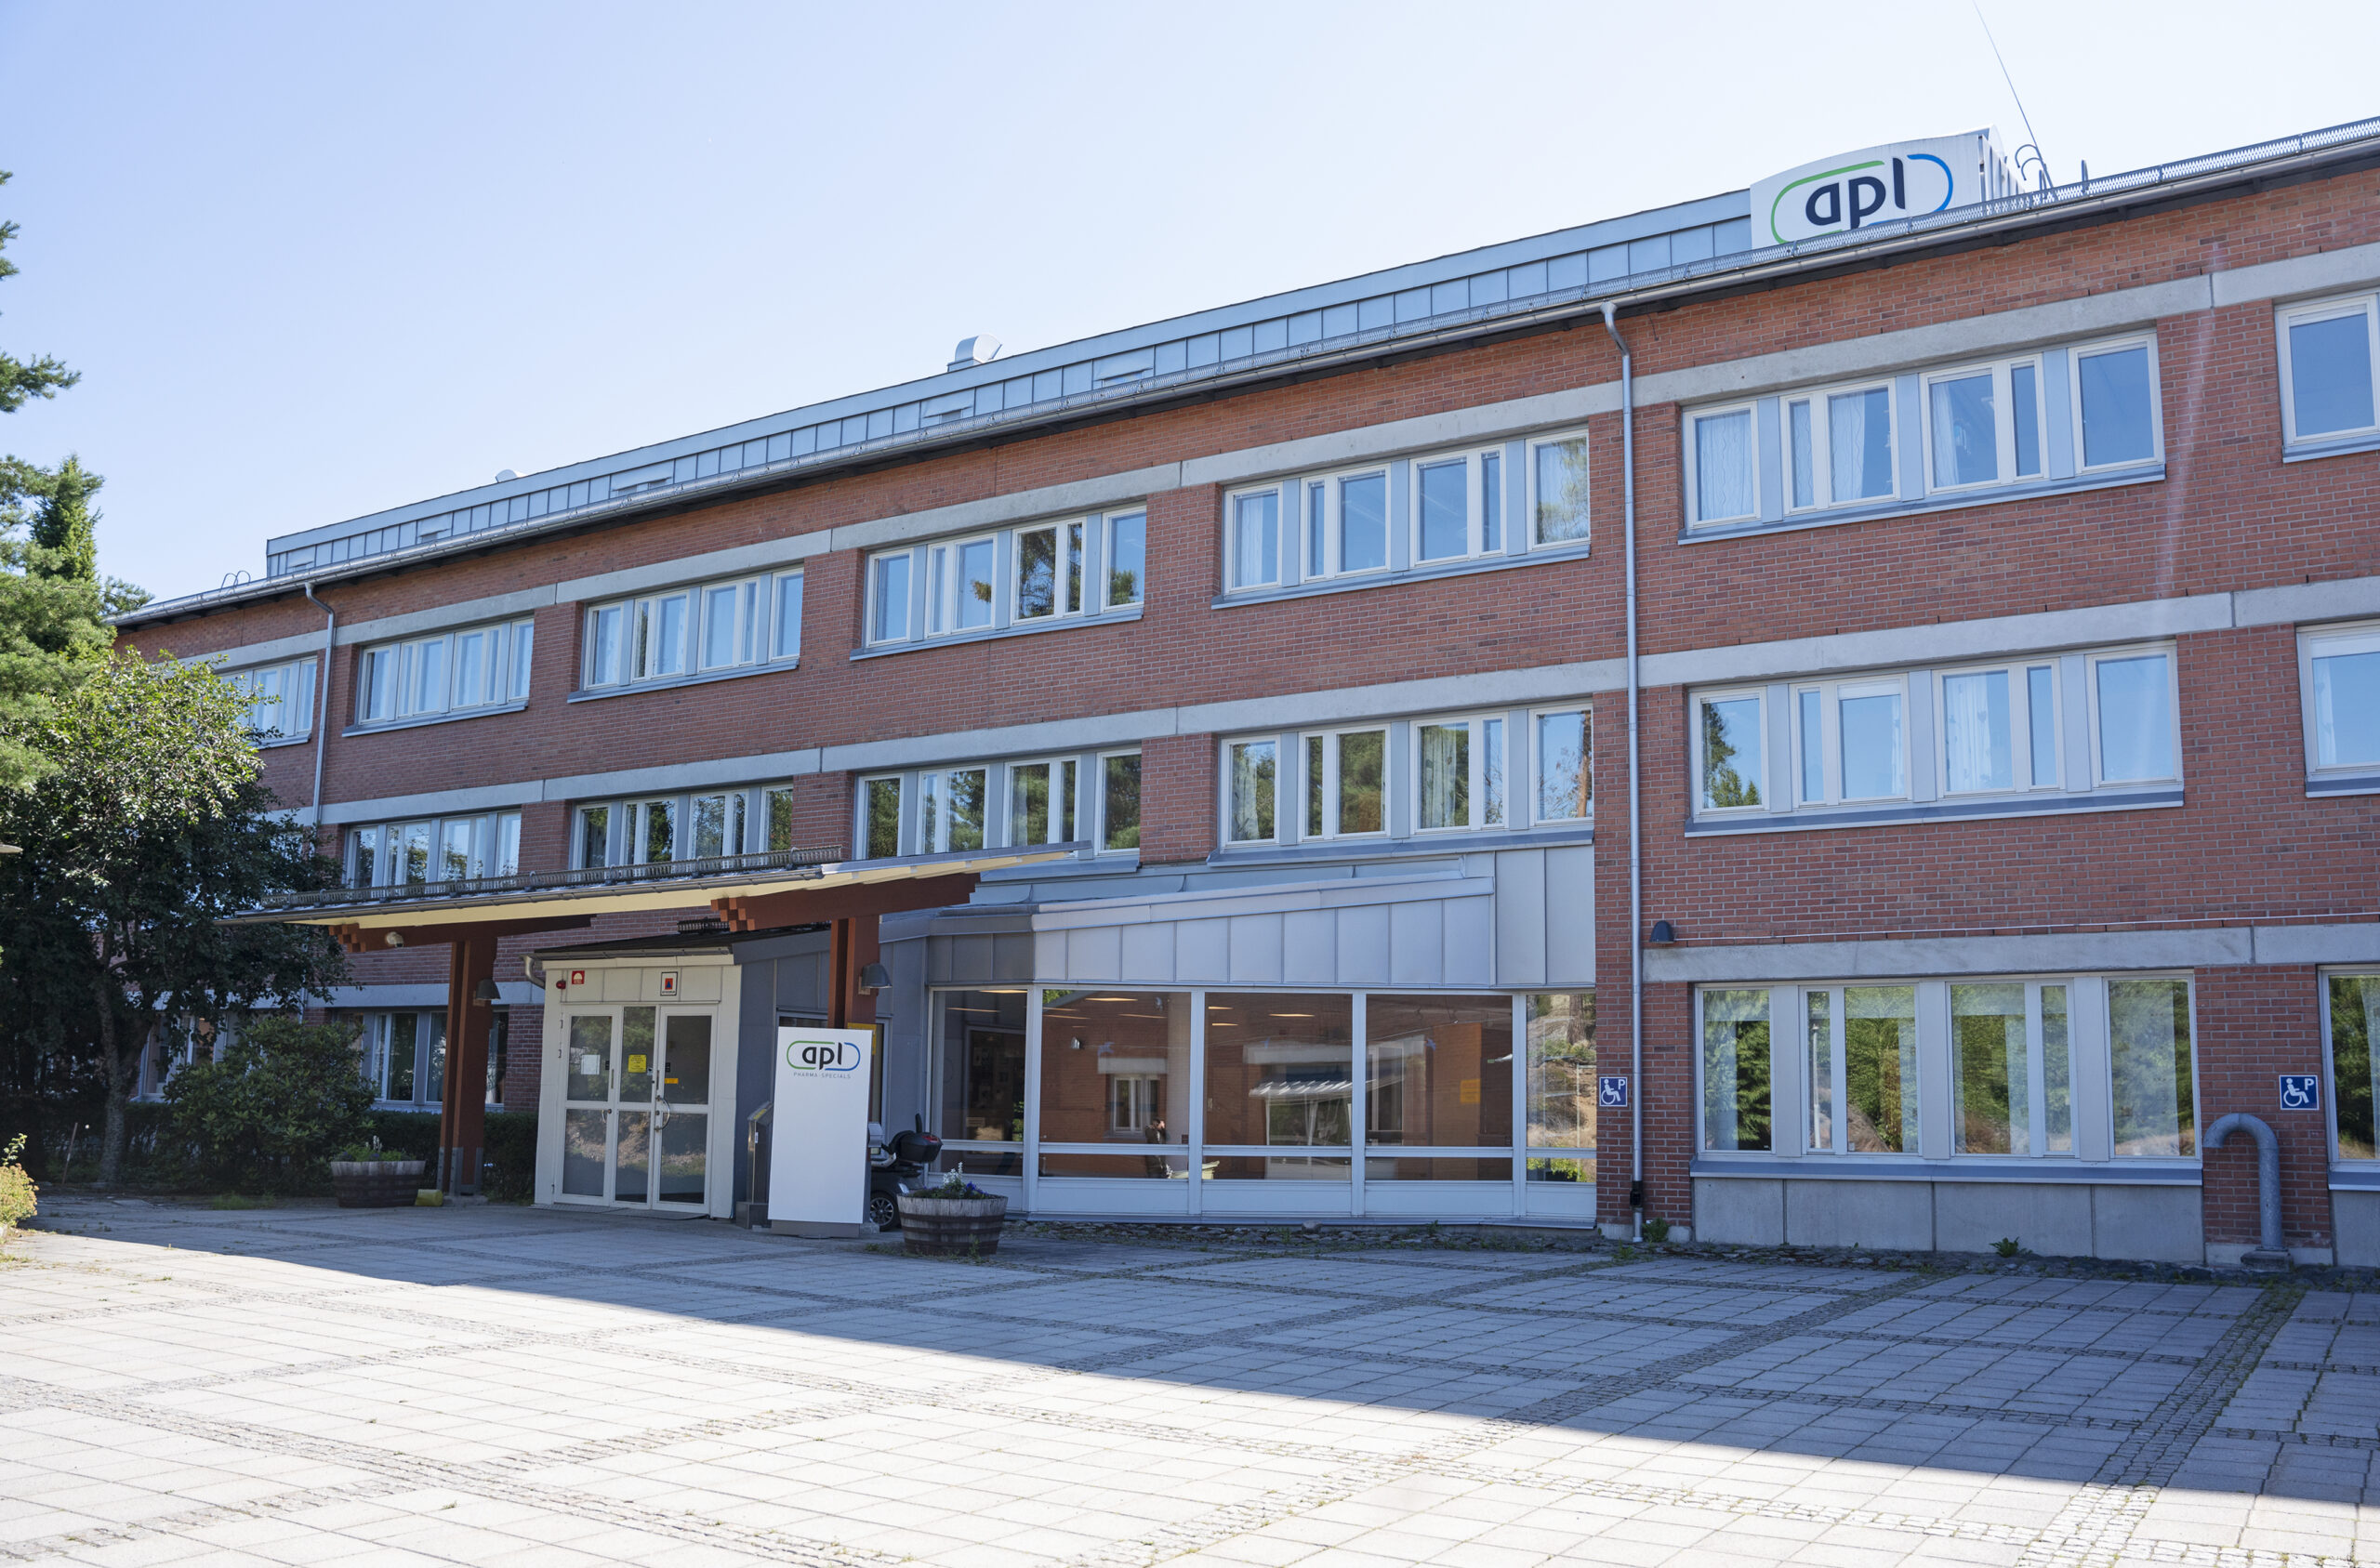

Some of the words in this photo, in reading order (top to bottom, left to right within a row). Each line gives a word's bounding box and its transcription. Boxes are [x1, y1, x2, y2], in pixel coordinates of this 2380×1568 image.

[1805, 157, 1906, 230] apl
[801, 1042, 842, 1070] apl
[1618, 1078, 1626, 1090] P
[2304, 1078, 2315, 1090] P
